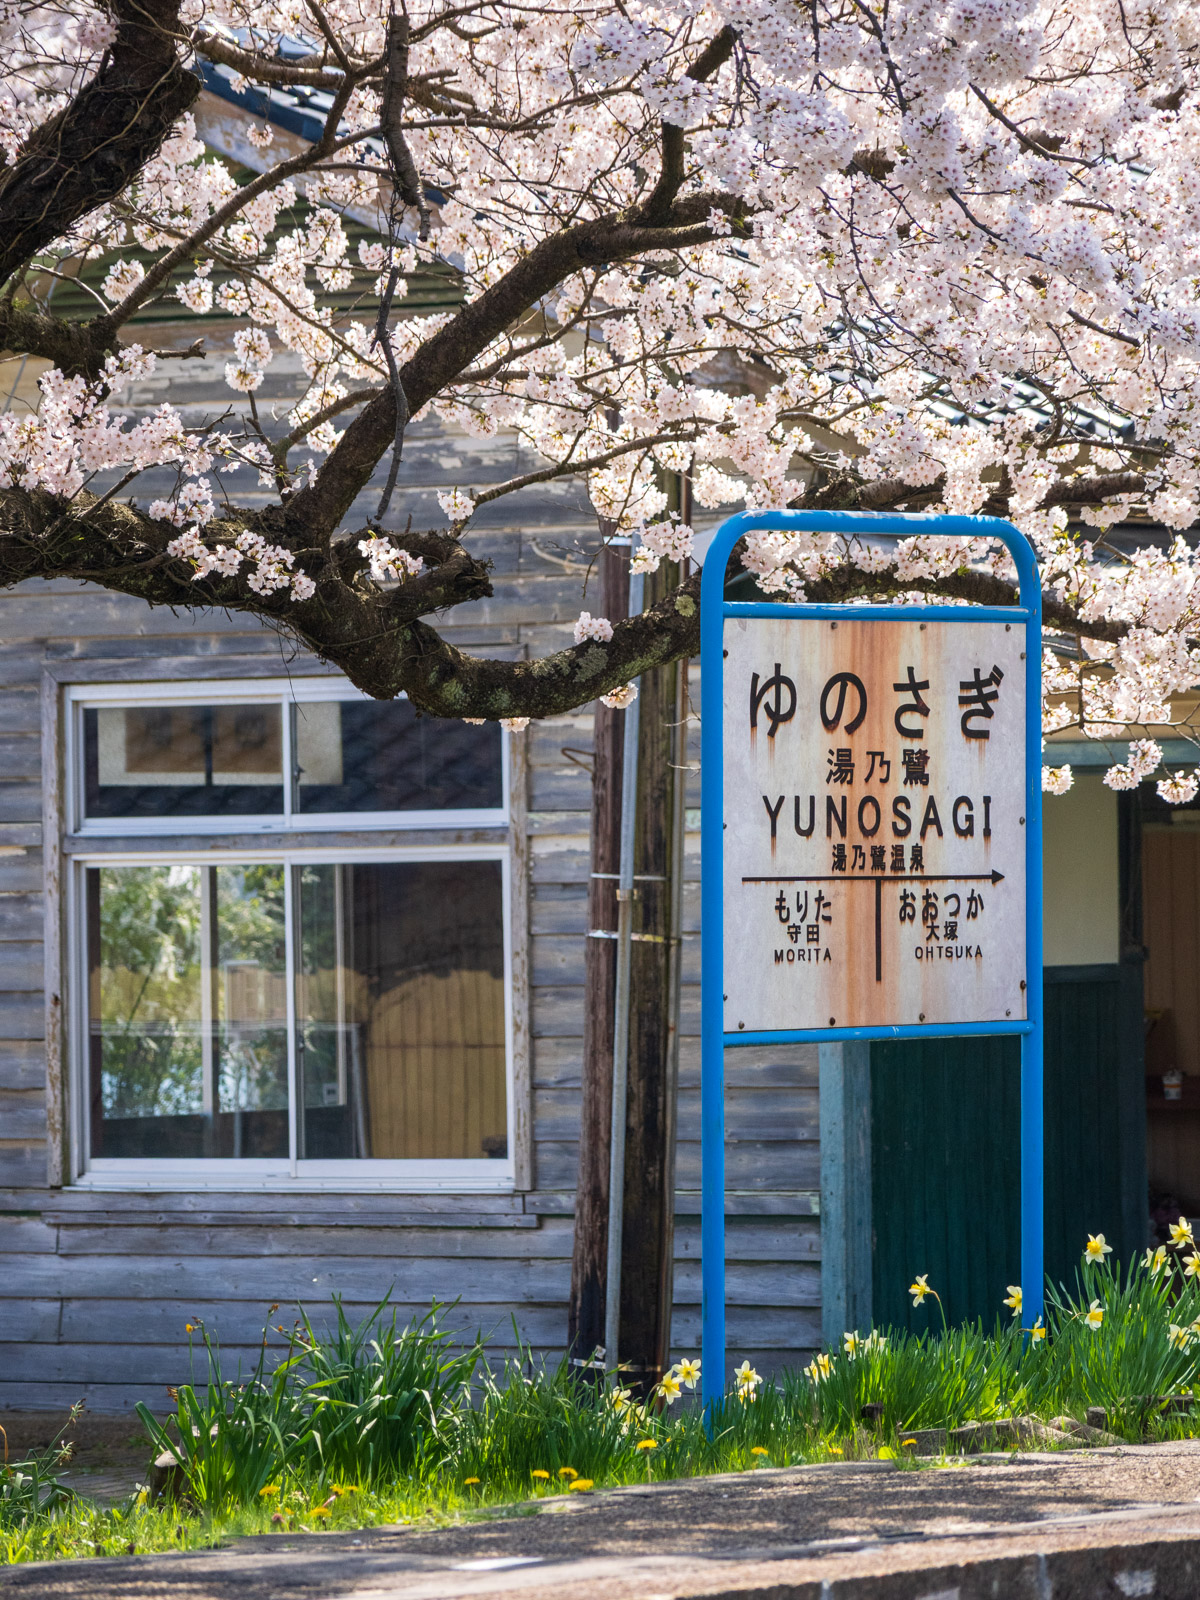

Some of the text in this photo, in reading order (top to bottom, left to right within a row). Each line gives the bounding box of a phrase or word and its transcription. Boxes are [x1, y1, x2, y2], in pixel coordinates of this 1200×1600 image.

[750, 662, 1005, 738] ゆのさぎ
[826, 748, 930, 785] 湯乃鷺
[763, 795, 992, 838] YUNOSAGI
[832, 843, 924, 871] 湯乃鷺温泉
[775, 889, 832, 923] もりた
[899, 888, 985, 922] おおつか
[787, 923, 820, 943] 守田
[926, 921, 958, 941] 大塚
[775, 948, 832, 962] MORITA
[915, 945, 983, 959] OHTSUKA
